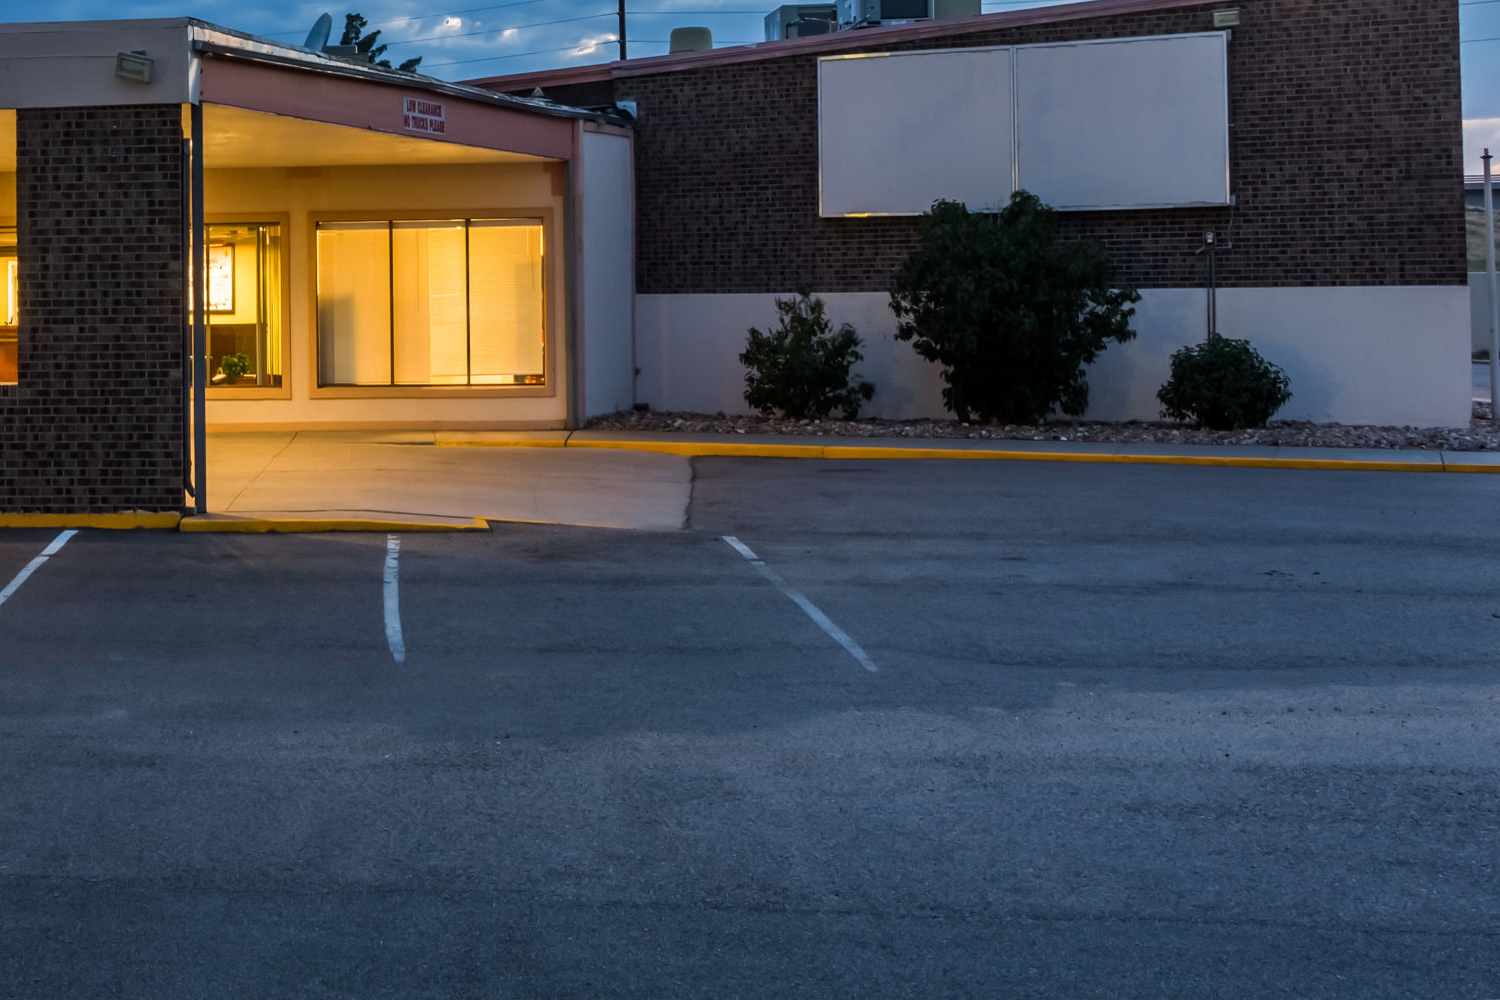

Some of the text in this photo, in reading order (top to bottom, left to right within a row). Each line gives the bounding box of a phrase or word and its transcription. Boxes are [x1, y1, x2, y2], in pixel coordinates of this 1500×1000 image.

[406, 99, 442, 118] LOW CLEARANCE
[403, 114, 445, 133] NO TRUCKS PLEASE
